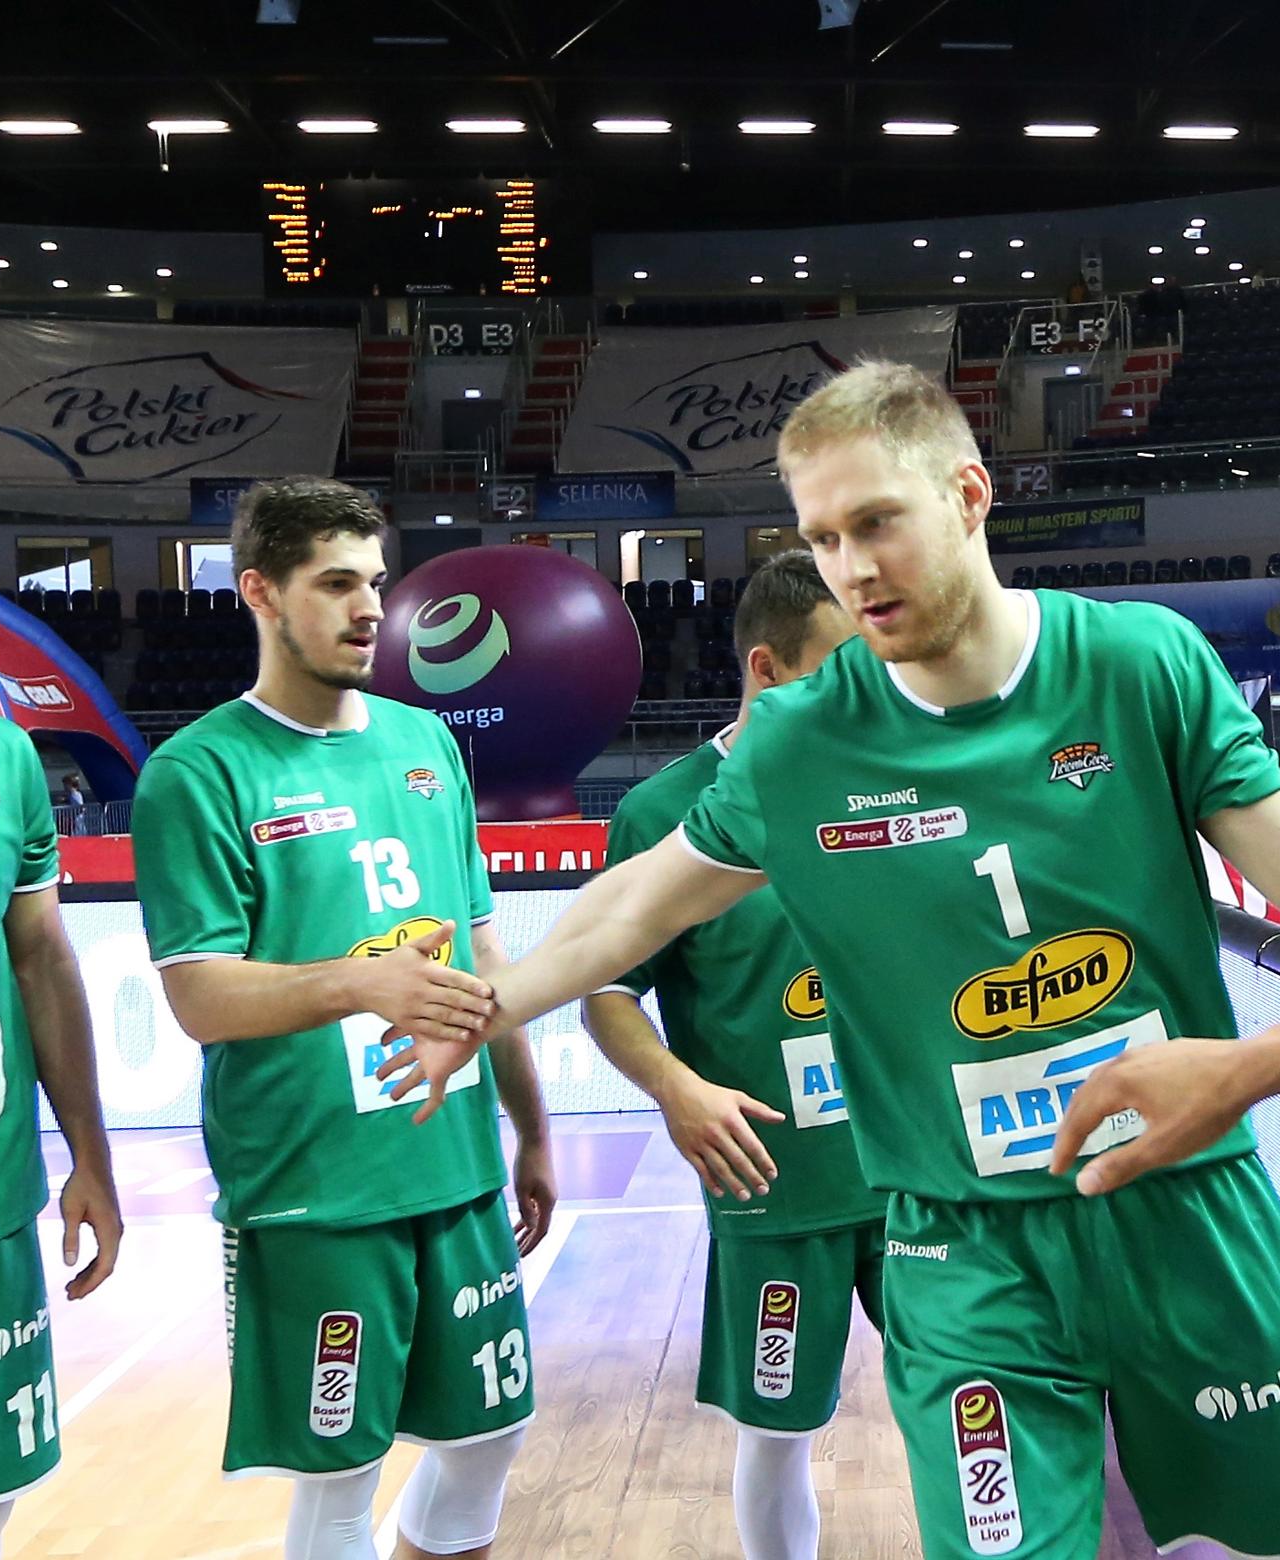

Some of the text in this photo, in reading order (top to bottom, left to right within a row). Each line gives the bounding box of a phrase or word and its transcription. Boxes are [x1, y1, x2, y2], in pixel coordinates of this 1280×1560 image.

[429, 323, 514, 347] D3 E3
[1031, 321, 1061, 346] E3
[44, 383, 216, 429] Polski
[665, 372, 819, 427] Polski
[74, 411, 259, 457] Cukier
[1014, 464, 1049, 492] F2
[493, 483, 527, 511] E2
[558, 482, 649, 507] SELENKA
[1027, 510, 1088, 531] MIASTEM
[1089, 504, 1142, 525] SPORTU
[427, 706, 505, 729] nerga
[847, 787, 919, 813] SPALDING
[269, 820, 305, 836] Energa
[918, 811, 958, 827] Basket
[844, 828, 884, 843] Energa
[920, 825, 945, 839] Liga
[349, 837, 421, 914] 13
[972, 843, 1032, 939] 1
[886, 1240, 949, 1262] SPALDING
[763, 1314, 793, 1324] Energa
[321, 1346, 353, 1357] Energa
[472, 1327, 529, 1410] 13
[757, 1367, 790, 1380] Basket
[762, 1379, 784, 1391] Liga
[6, 1370, 57, 1458] 11
[313, 1405, 352, 1416] Basket
[319, 1417, 344, 1428] Liga
[962, 1428, 1000, 1444] Energa
[968, 1509, 1017, 1528] Basket
[979, 1525, 1011, 1542] Liga
